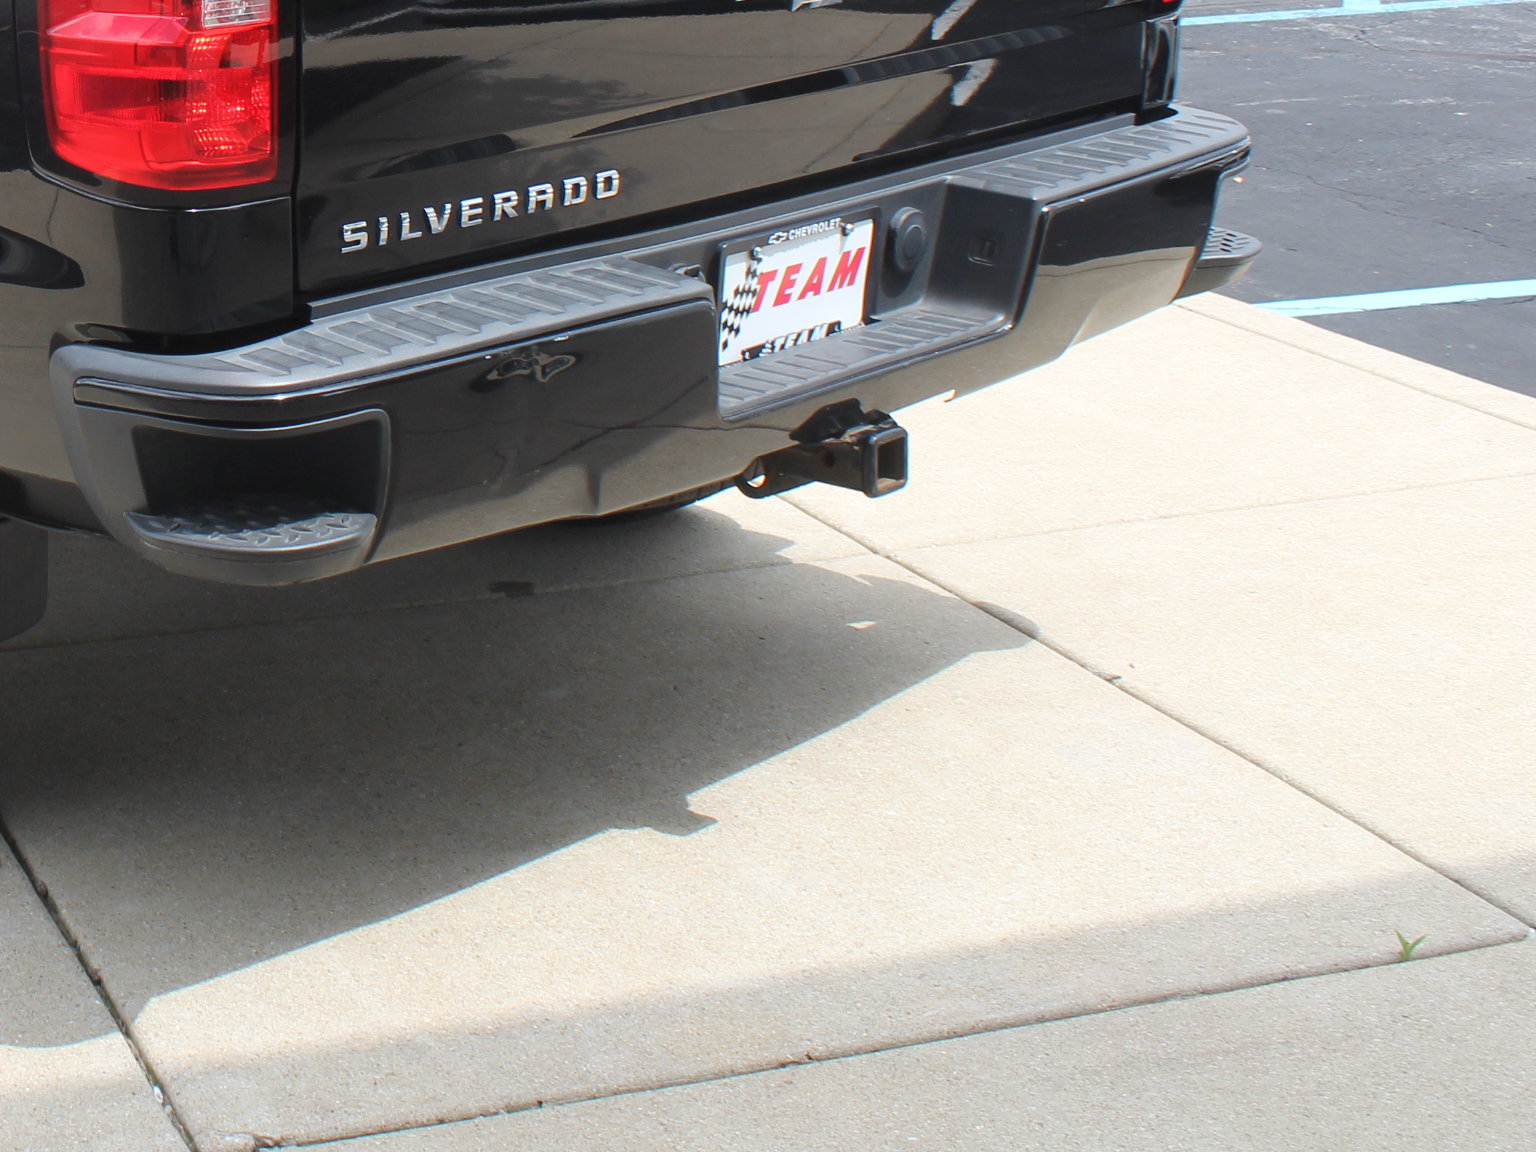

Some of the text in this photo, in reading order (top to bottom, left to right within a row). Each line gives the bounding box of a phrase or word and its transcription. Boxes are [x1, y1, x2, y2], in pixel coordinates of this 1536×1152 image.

[341, 169, 620, 254] SILVERADO
[788, 218, 842, 240] CHEVROLET
[750, 247, 866, 313] TEAM
